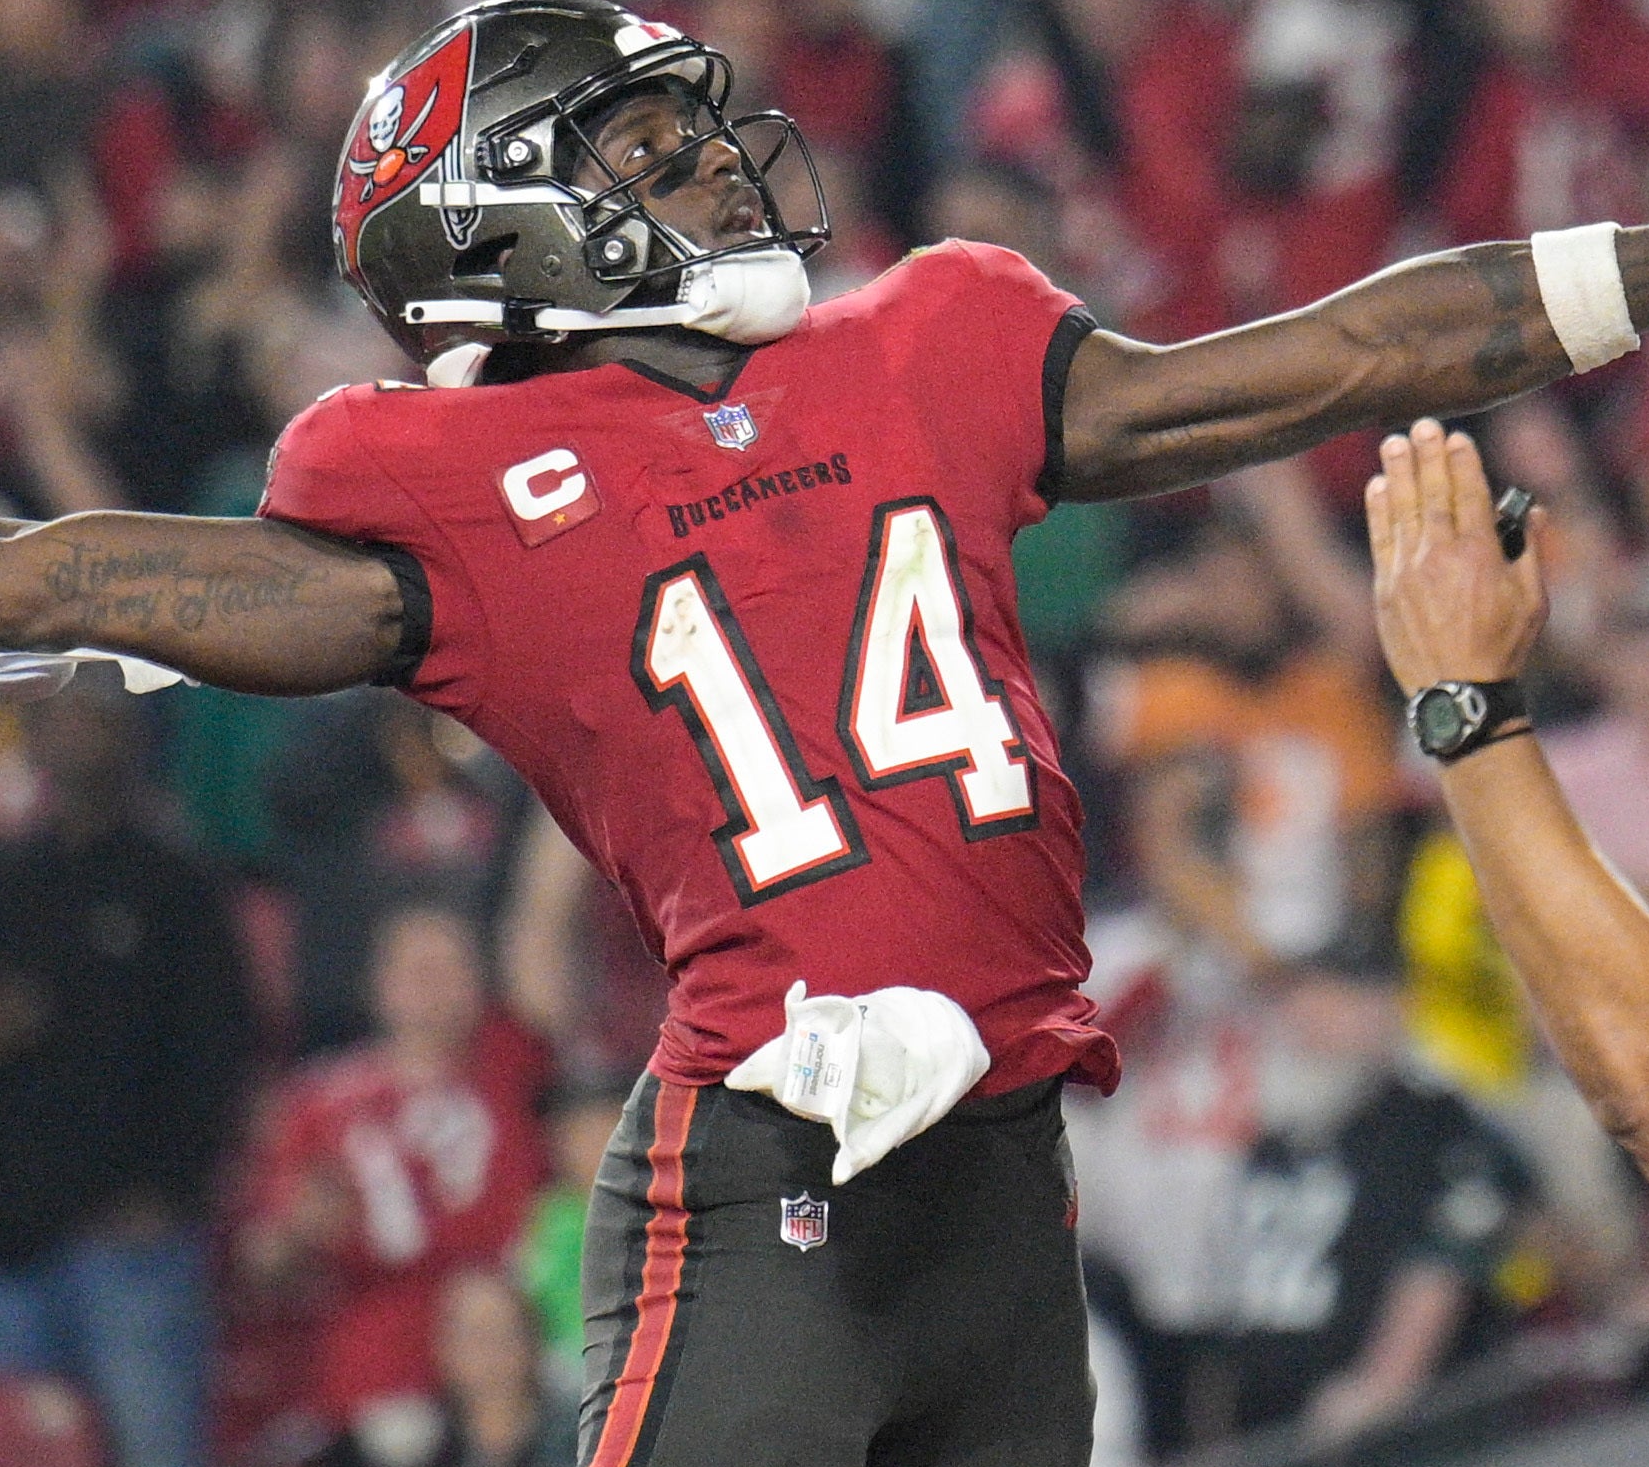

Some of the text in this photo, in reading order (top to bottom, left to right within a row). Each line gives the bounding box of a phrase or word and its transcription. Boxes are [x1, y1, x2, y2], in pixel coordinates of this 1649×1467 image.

[720, 421, 753, 445] NFL
[502, 447, 587, 522] C
[667, 452, 852, 538] BUCCANEERS
[630, 495, 1040, 910] 14
[790, 1219, 823, 1241] NFL
